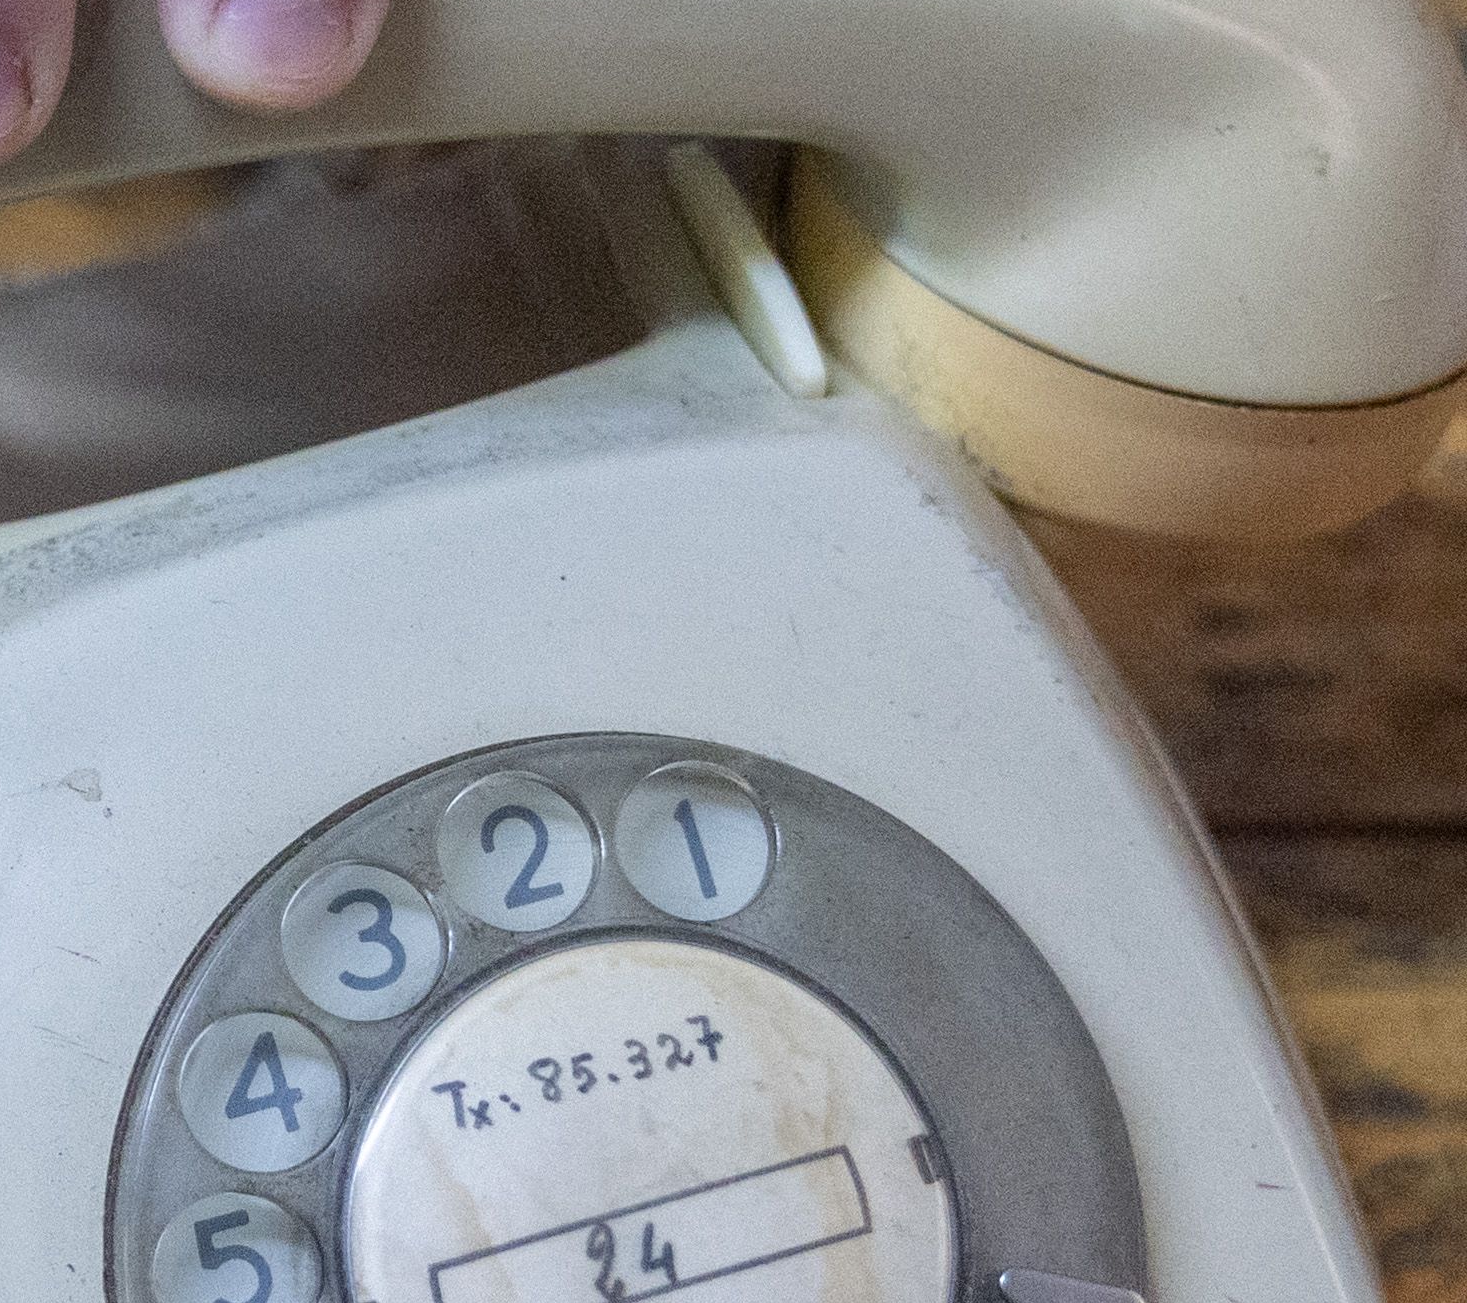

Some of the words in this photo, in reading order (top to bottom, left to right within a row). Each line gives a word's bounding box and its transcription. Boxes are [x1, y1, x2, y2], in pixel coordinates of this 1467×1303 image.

[479, 804, 564, 909] 2
[670, 798, 719, 900] 1
[325, 887, 406, 991] 3
[224, 1031, 302, 1132] 4
[526, 1014, 725, 1104] 85.327
[586, 1221, 678, 1302] 24
